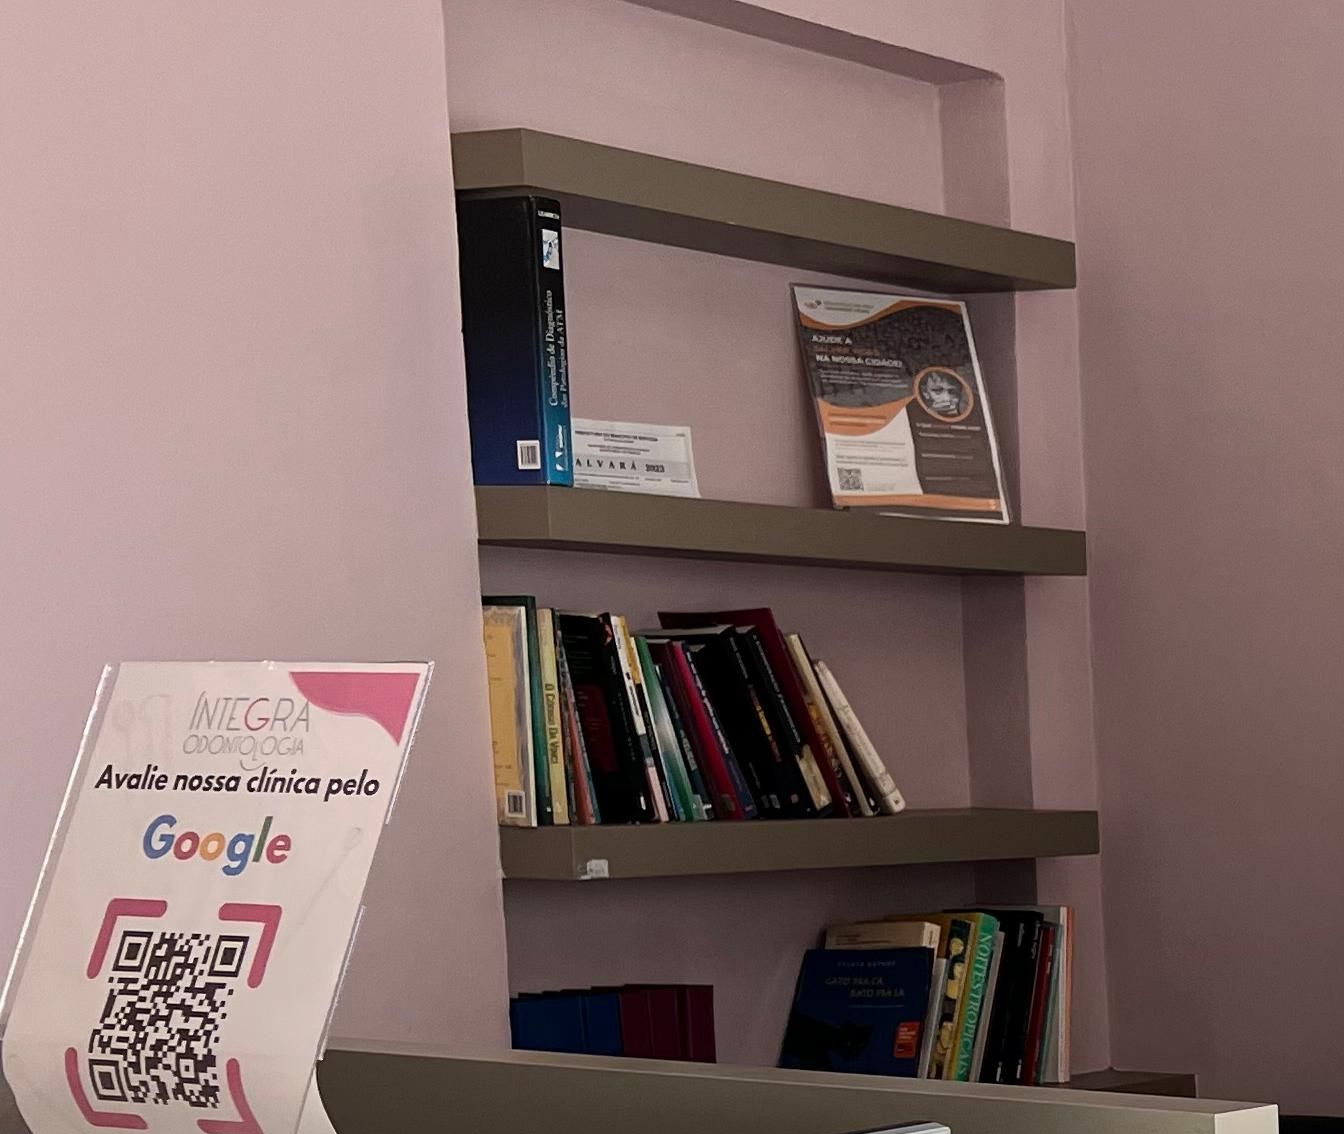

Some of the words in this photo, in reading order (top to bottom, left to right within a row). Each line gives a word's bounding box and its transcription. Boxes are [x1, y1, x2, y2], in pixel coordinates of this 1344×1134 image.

[182, 735, 305, 761] ODONTOLOGIA
[95, 764, 168, 790] Avalie
[173, 776, 241, 792] nossa
[246, 766, 321, 794] clínica
[323, 769, 380, 802] pelo
[142, 815, 292, 876] Google
